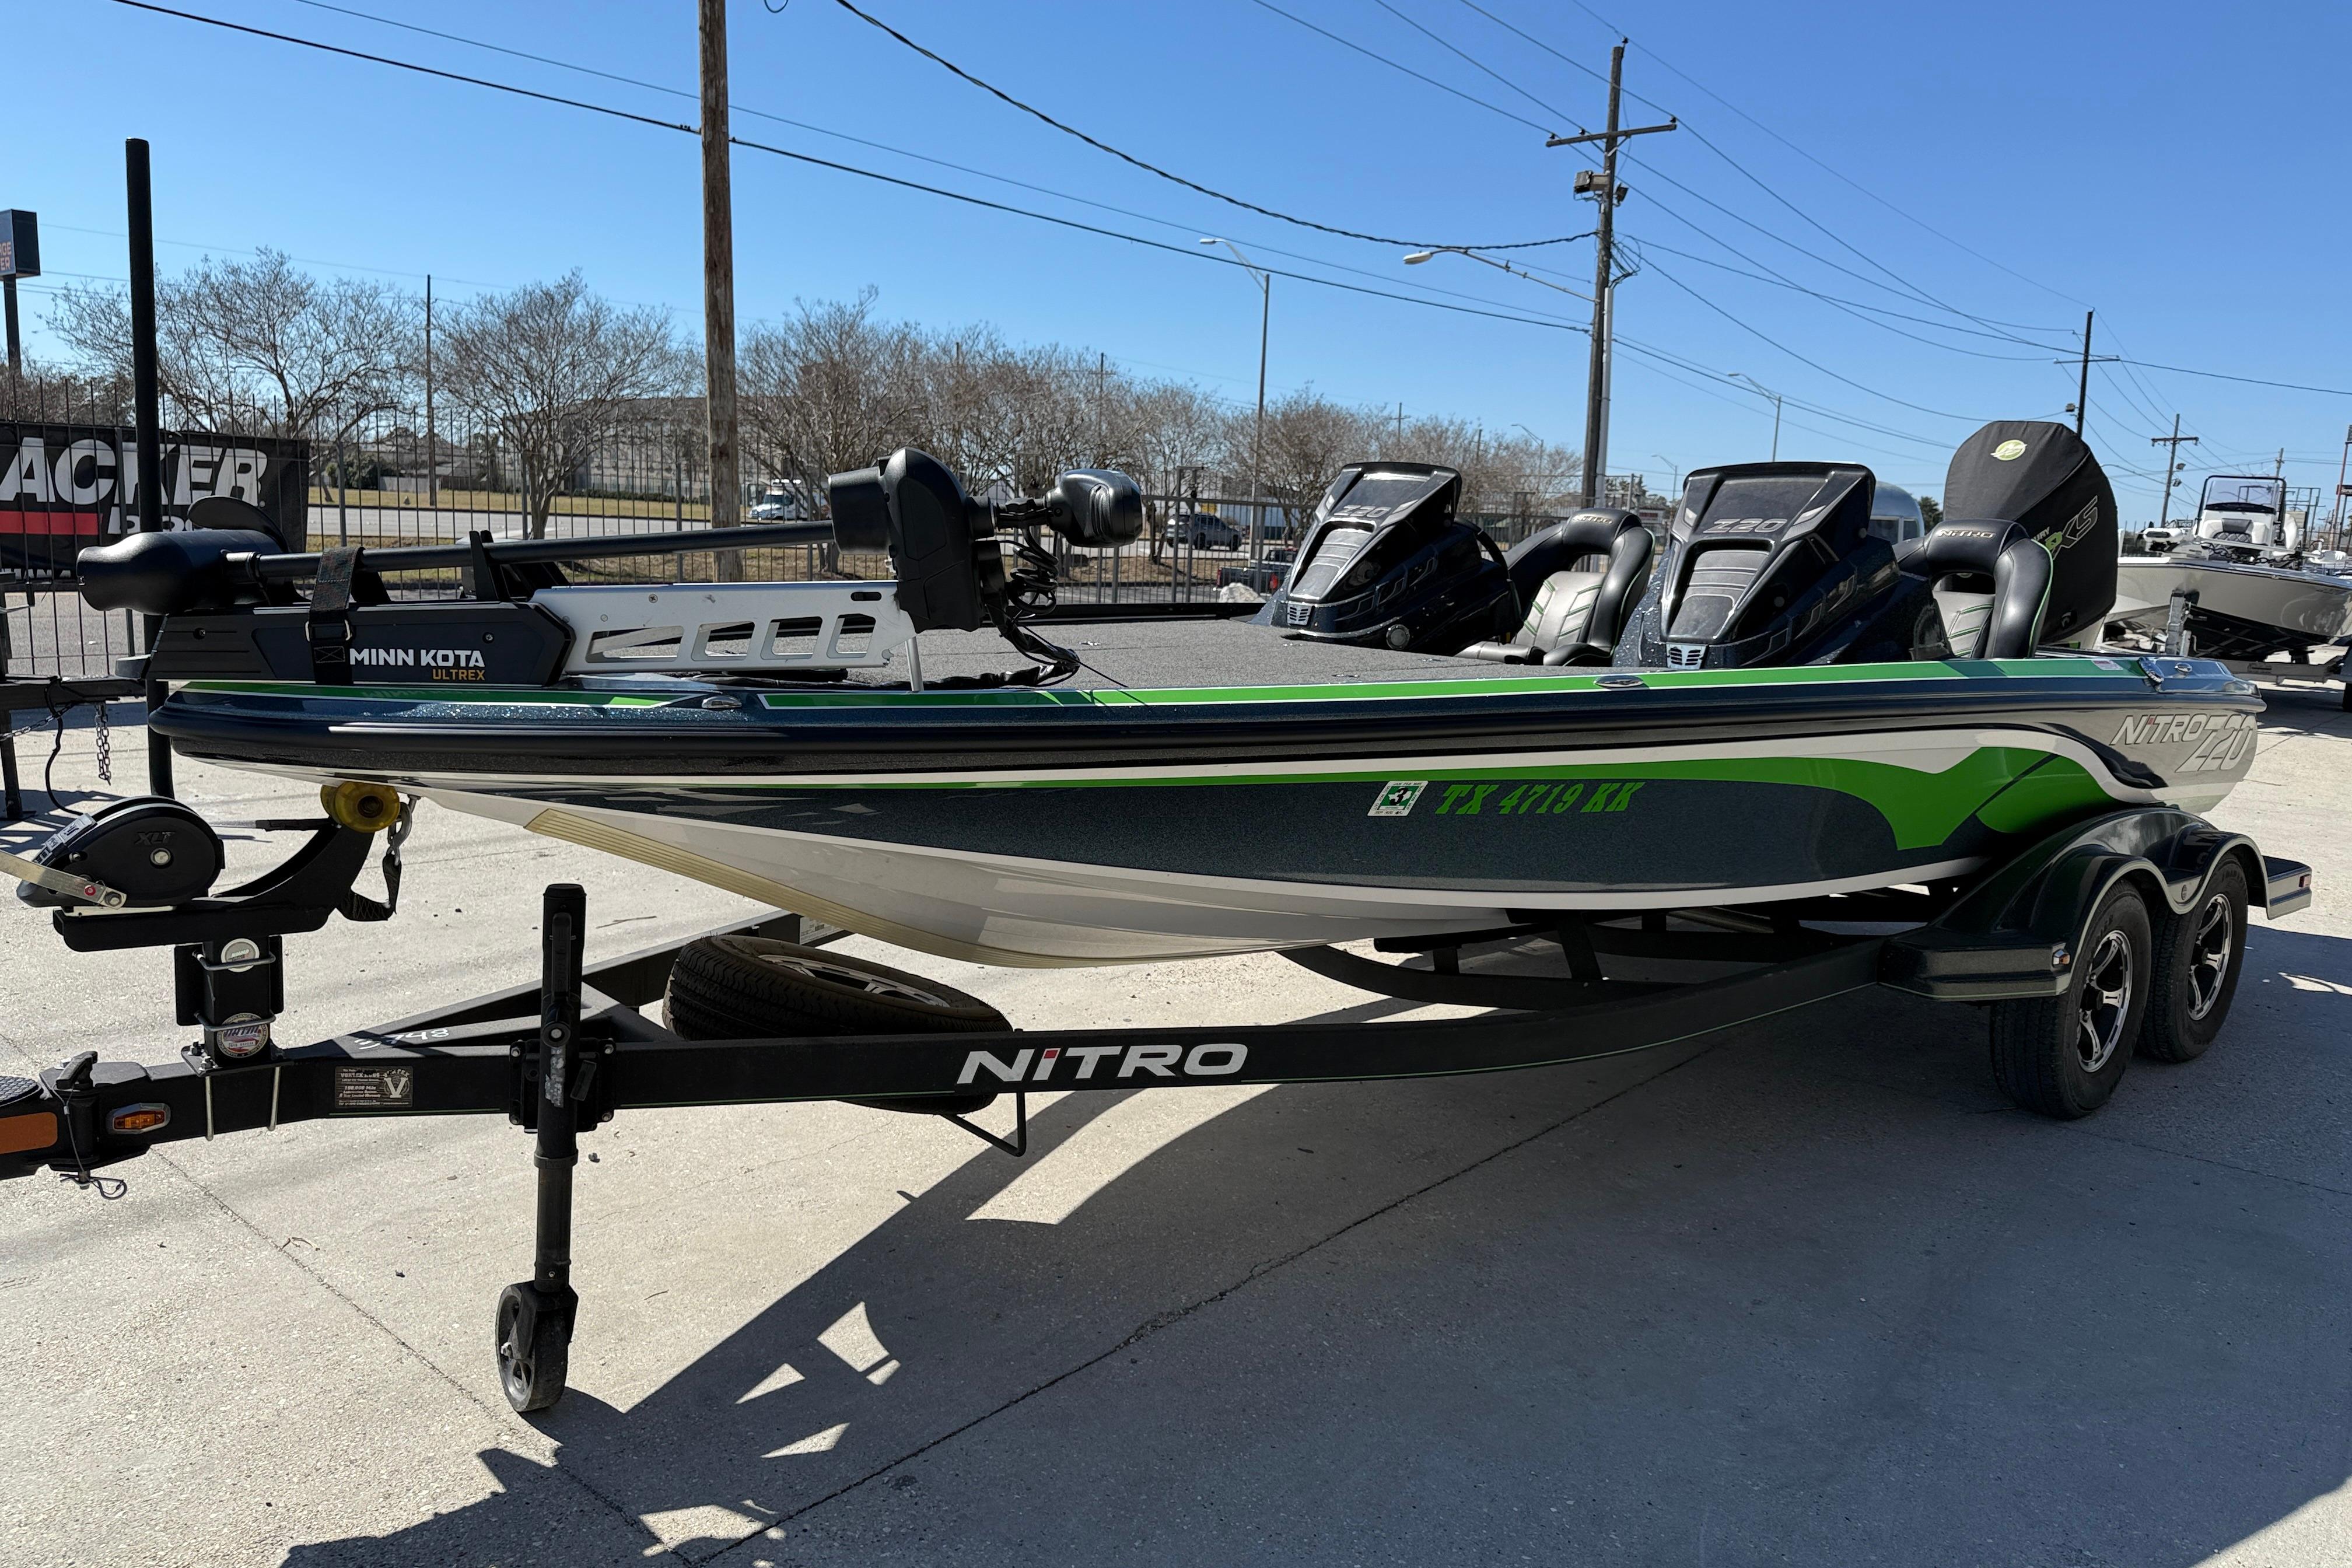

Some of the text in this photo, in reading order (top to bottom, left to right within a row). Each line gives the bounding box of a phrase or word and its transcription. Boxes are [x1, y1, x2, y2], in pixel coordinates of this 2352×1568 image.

[1703, 518, 1788, 533] Z20
[350, 648, 485, 667] MINN KOTA
[432, 669, 485, 681] ULTREX
[1390, 787, 1410, 806] 3
[1434, 782, 1646, 814] TX 4719 KK
[956, 1043, 1248, 1084] NITRO
